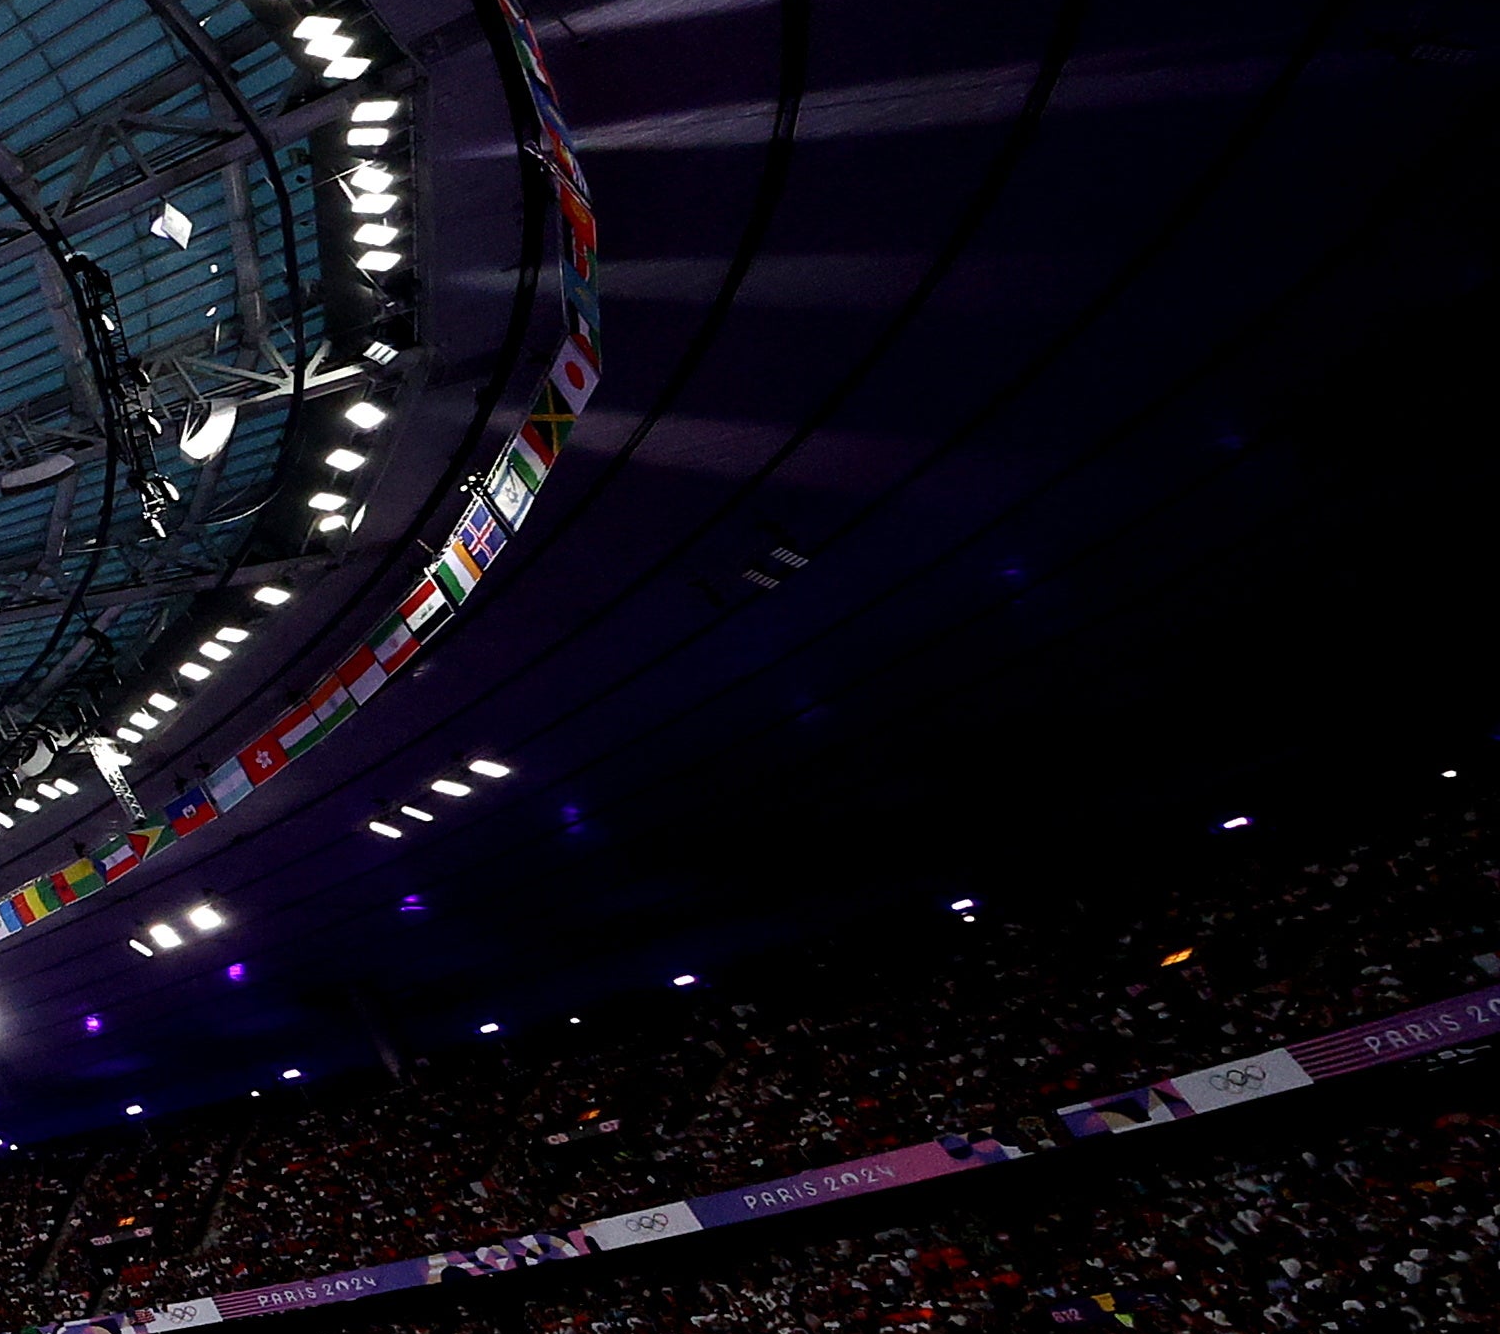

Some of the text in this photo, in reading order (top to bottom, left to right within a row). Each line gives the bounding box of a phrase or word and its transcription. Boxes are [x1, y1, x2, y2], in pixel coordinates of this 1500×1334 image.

[1363, 1014, 1461, 1055] PARIS
[743, 1164, 897, 1210] PARIS 2024
[257, 1276, 377, 1307] PARIS 2024
